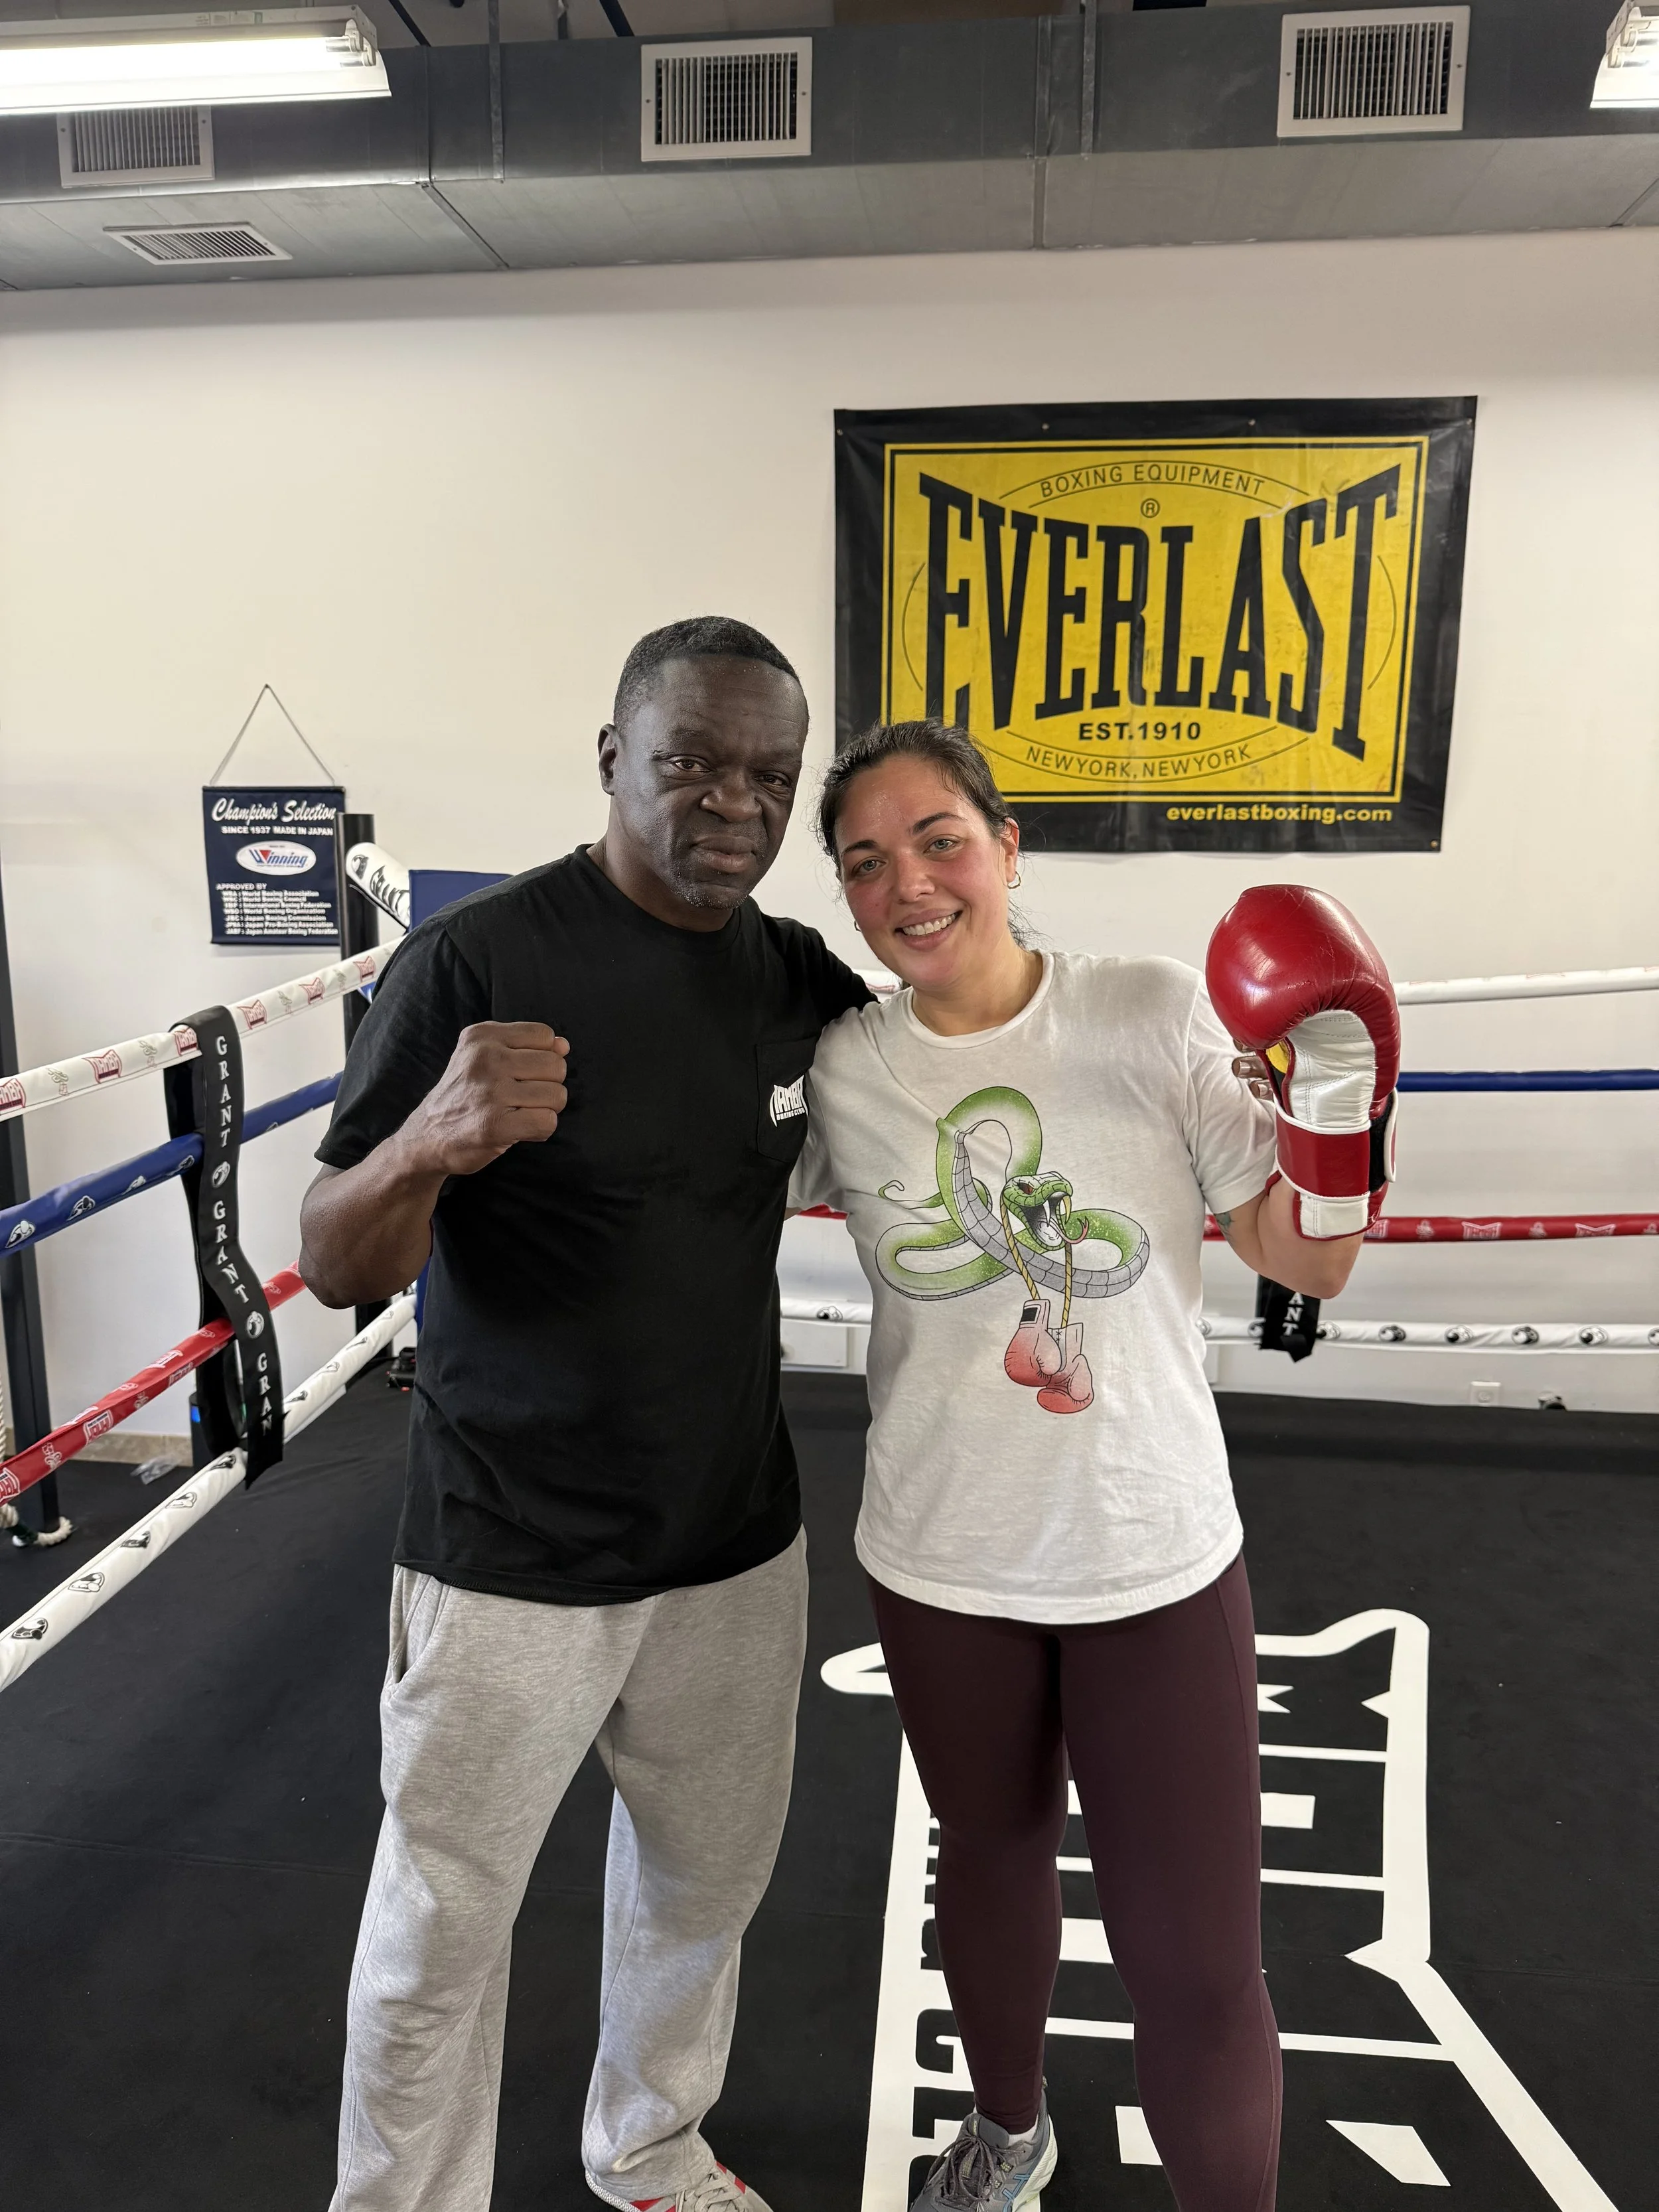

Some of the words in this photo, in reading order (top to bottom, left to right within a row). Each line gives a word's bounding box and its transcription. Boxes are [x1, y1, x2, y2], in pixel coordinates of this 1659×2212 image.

[1040, 466, 1123, 498] BOXING
[1133, 465, 1265, 496] EQUIPMENT
[919, 463, 1401, 761] EVERLAST
[1078, 721, 1201, 741] EST.1910
[281, 800, 336, 823] Selection
[1166, 804, 1392, 825] everlastboxing.com
[221, 826, 249, 834] SINCE
[273, 826, 297, 835] MADE
[249, 849, 308, 868] Winning
[216, 1035, 232, 1148] GRANT
[776, 1110, 794, 1121] BOXING
[794, 1107, 806, 1116] CLUB
[214, 1200, 250, 1303] GRANT
[1282, 1291, 1305, 1336] ANT
[257, 1353, 272, 1436] GRAN
